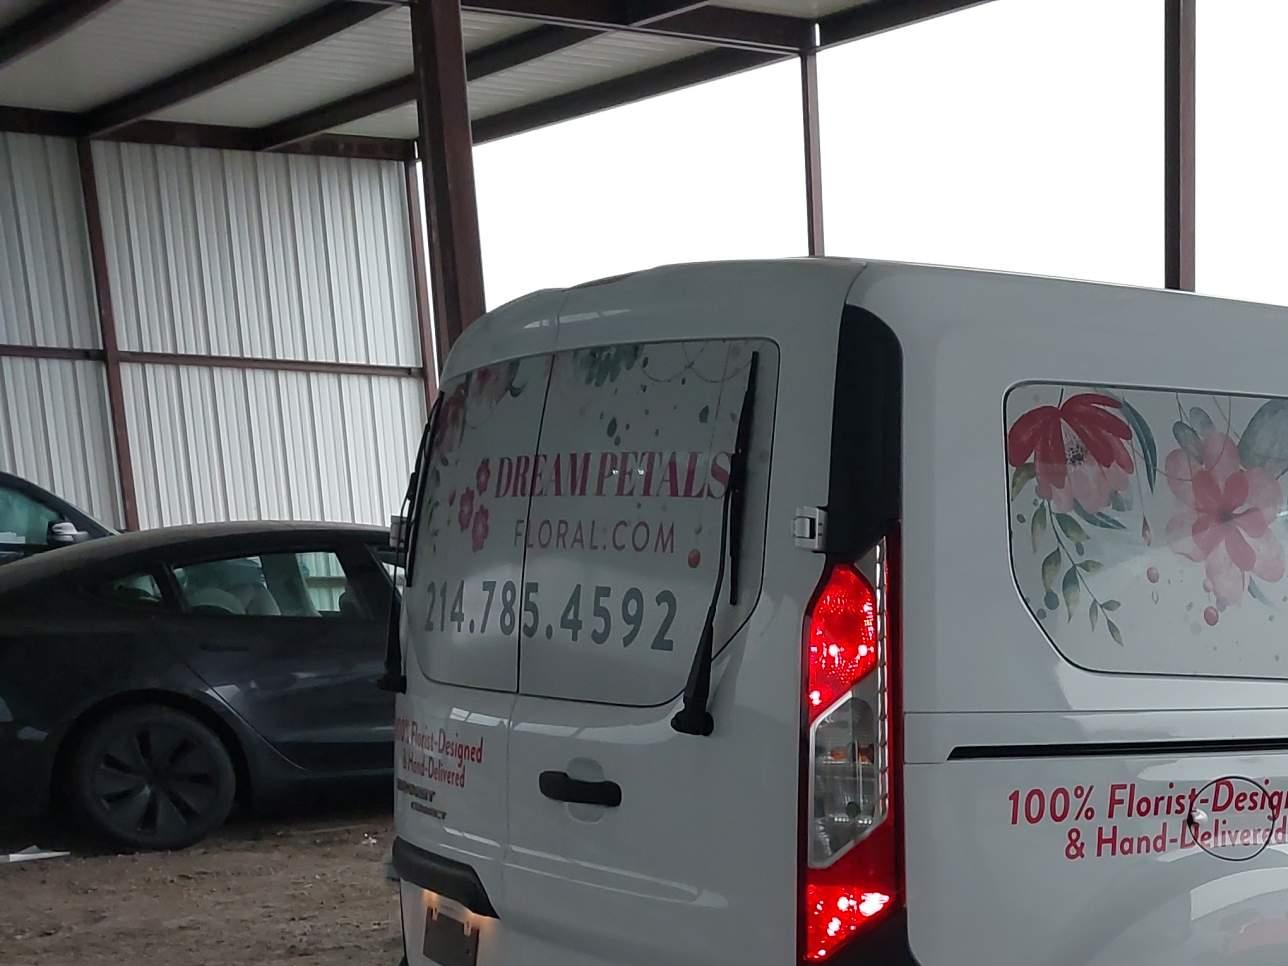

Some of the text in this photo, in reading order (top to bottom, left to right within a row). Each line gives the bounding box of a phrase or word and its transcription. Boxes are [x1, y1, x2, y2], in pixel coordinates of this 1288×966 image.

[513, 519, 675, 553] FLORAL.COM
[425, 580, 677, 651] 214.785.4592
[1008, 785, 1095, 825] 100%
[1064, 815, 1288, 860] & Hand-Delivered
